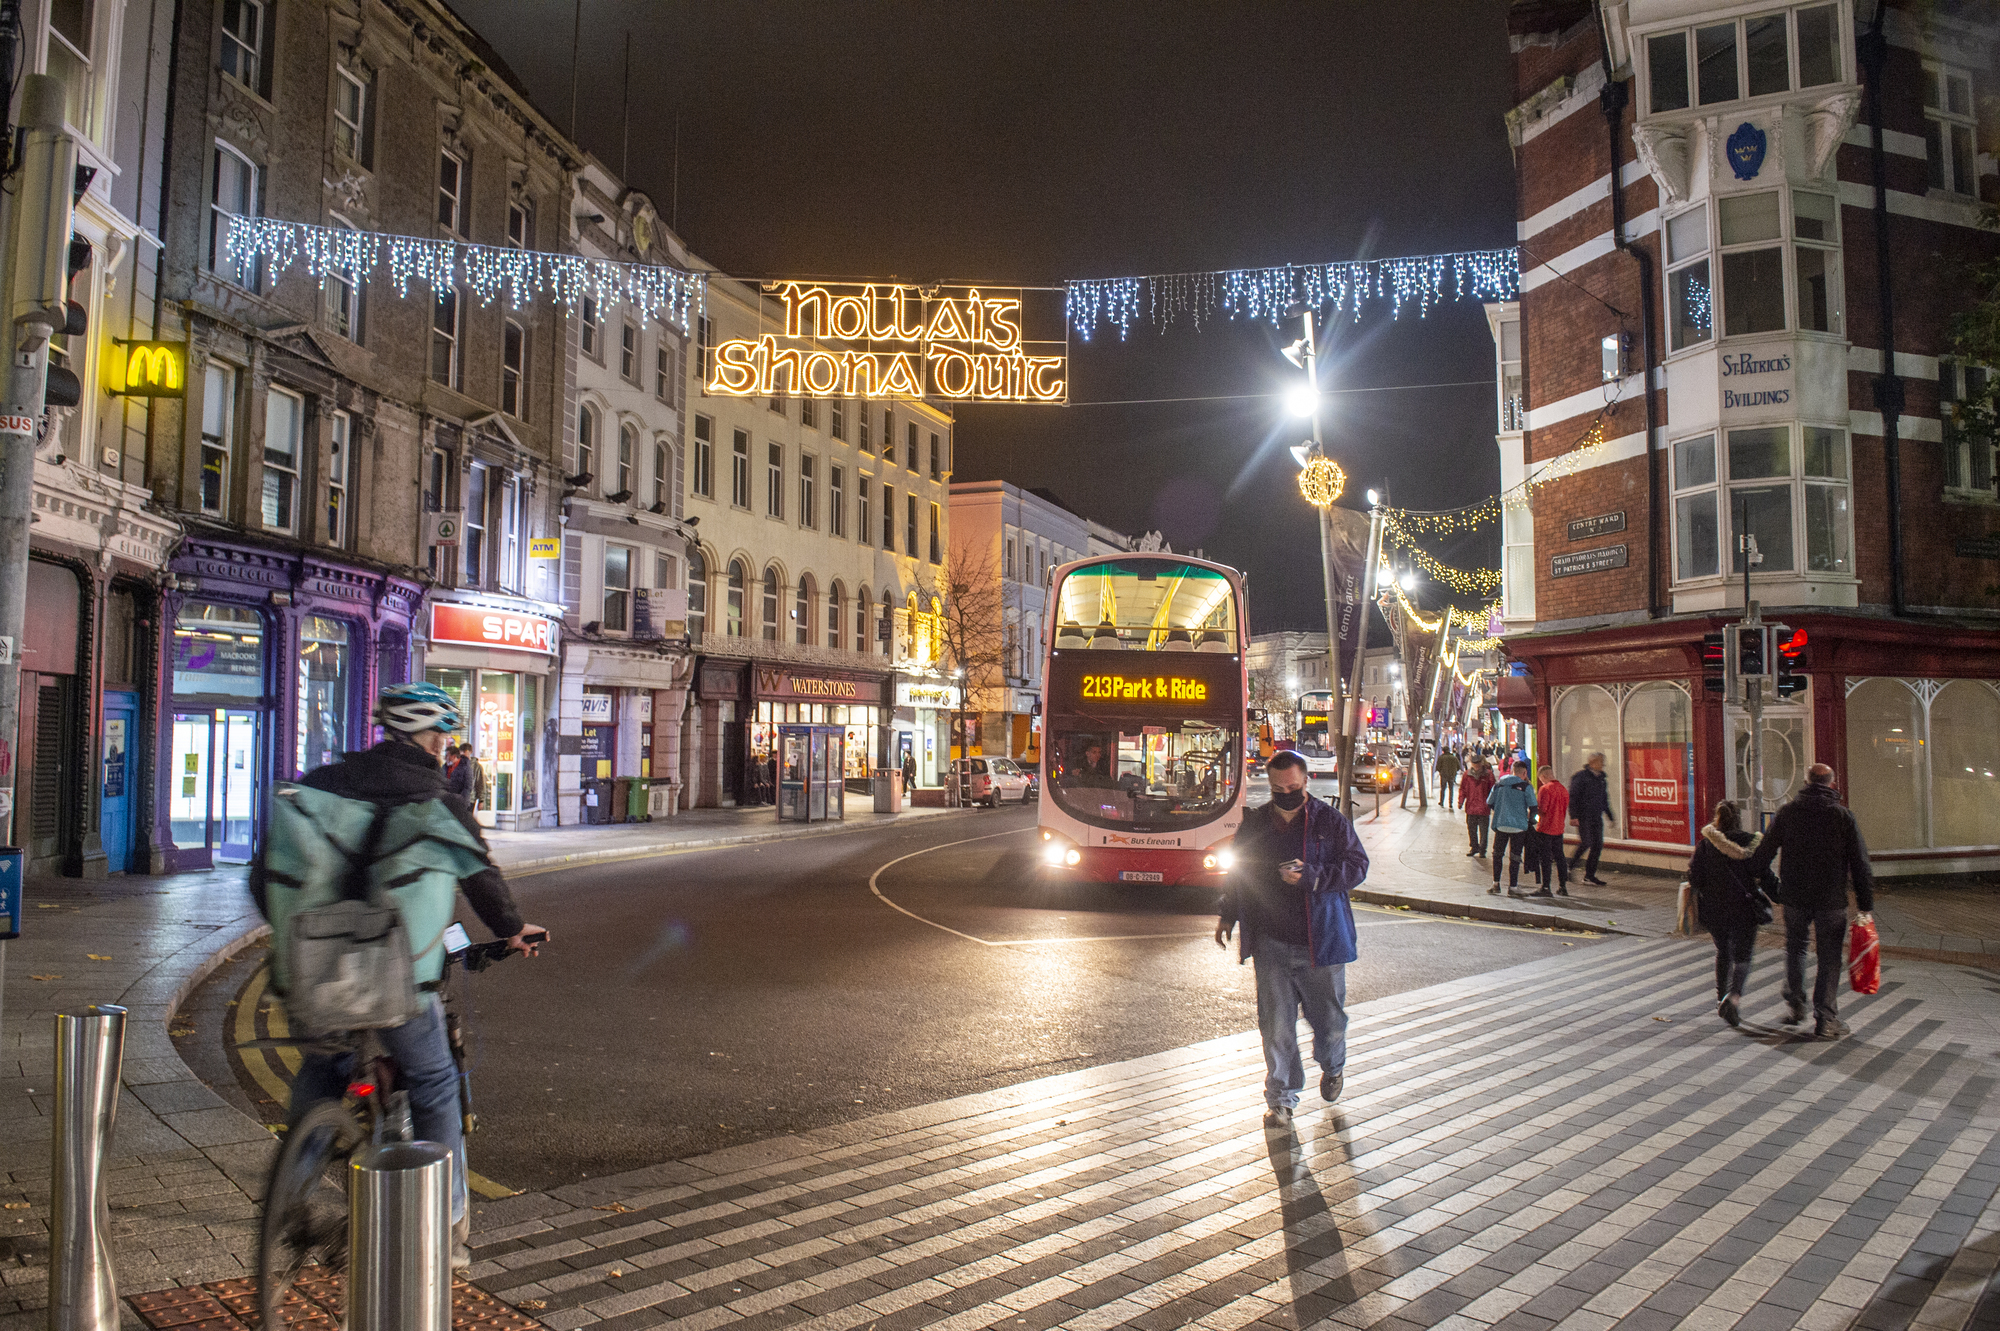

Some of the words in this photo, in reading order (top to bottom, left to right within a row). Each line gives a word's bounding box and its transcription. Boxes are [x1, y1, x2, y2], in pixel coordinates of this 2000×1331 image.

[1599, 515, 1619, 524] WARD
[1591, 558, 1614, 568] STREET
[635, 589, 647, 598] To
[1338, 574, 1355, 641] Rembrandt
[482, 615, 548, 646] SPAR
[220, 652, 257, 660] MACBOOKS
[230, 664, 256, 672] REPAIRS
[790, 677, 856, 697] WATERSTONES
[1156, 678, 1167, 698] &
[1171, 678, 1206, 700] Ride
[584, 728, 597, 737] Let
[1636, 783, 1674, 801] Lisney
[1130, 837, 1145, 845] Bus
